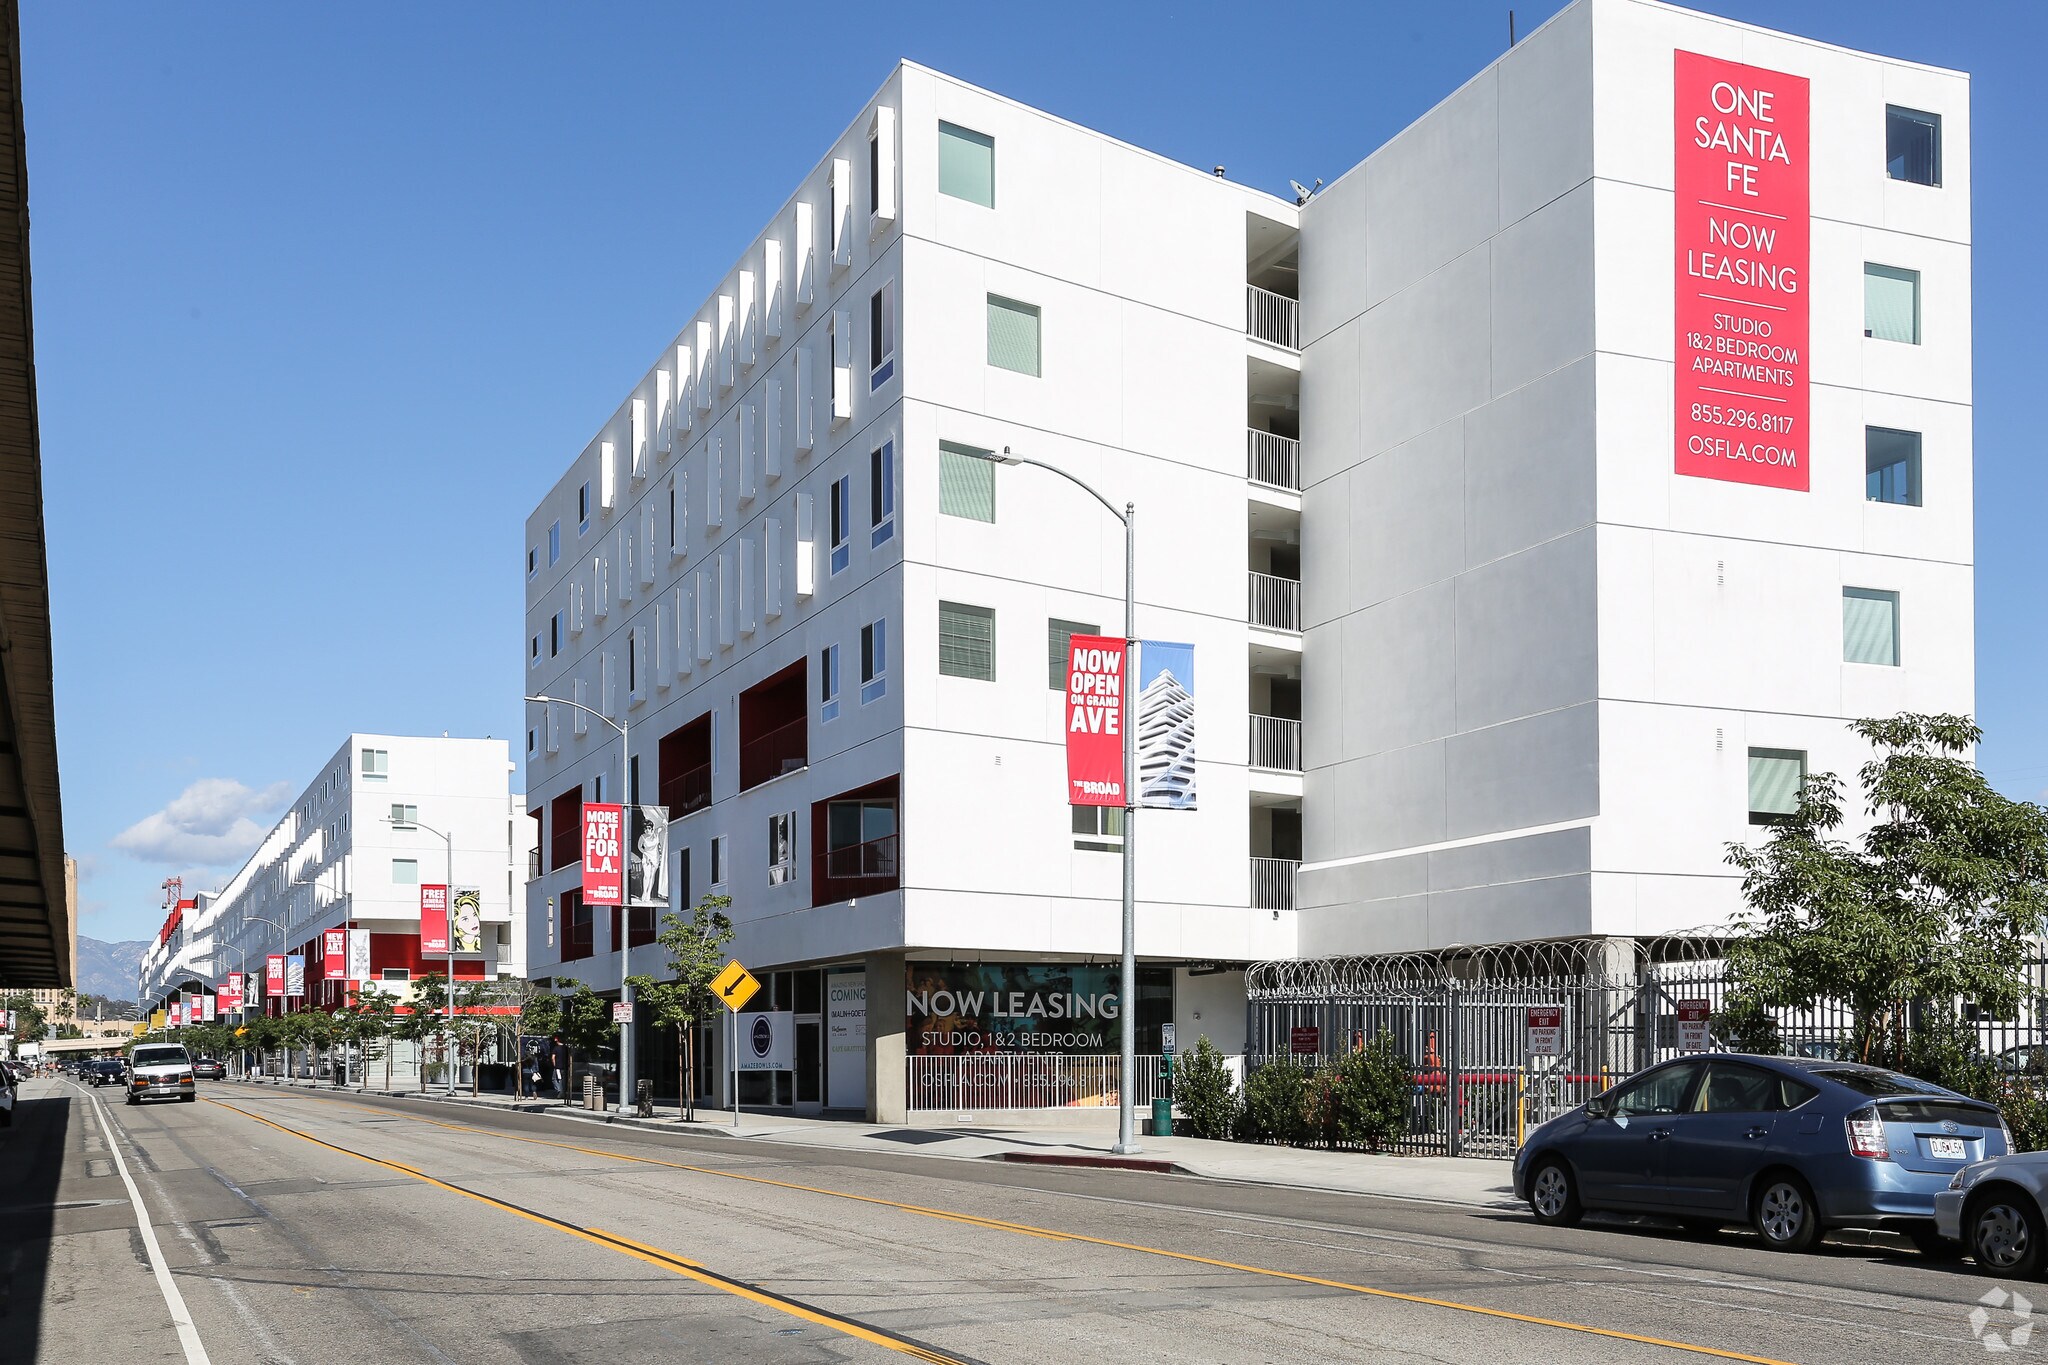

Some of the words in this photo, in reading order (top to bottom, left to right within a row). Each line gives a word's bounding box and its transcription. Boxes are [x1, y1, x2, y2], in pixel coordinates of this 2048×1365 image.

[1711, 81, 1775, 123] ONE
[1694, 116, 1791, 165] SANTA
[1727, 161, 1759, 196] FE
[1709, 217, 1776, 254] NOW
[1688, 249, 1798, 293] LEASING
[1713, 313, 1772, 338] STUDIO
[1686, 331, 1713, 351] 1&2
[1716, 336, 1799, 365] BEDROOM
[1692, 356, 1794, 387] APARTMENTS
[1691, 402, 1794, 435] 855.296.8117
[1688, 435, 1797, 468] OSFLA.COM
[1072, 648, 1121, 674] NOW
[1070, 672, 1120, 696] OPEN
[1070, 693, 1084, 706] ON
[1086, 694, 1119, 708] GRAND
[1070, 705, 1119, 735] AVE
[1073, 780, 1084, 788] THE
[1084, 781, 1120, 796] BROAD
[586, 811, 618, 823] MORE
[586, 823, 618, 839] ART
[586, 839, 618, 857] FOR
[586, 856, 618, 873] L.A.
[423, 889, 445, 899] FREE
[594, 890, 618, 898] BROAD
[326, 932, 343, 941] NEW
[326, 942, 343, 951] ART
[831, 988, 866, 1002] COMING
[906, 990, 985, 1017] NOW
[994, 992, 1119, 1019] LEASING
[1531, 1009, 1558, 1017] EMERGENCY
[1681, 1002, 1708, 1010] EMERGENCY
[1539, 1018, 1549, 1026] EXIT
[1689, 1011, 1699, 1019] EXIT
[922, 1031, 984, 1049] STUDIO,
[988, 1032, 1016, 1047] 1&2
[1022, 1033, 1103, 1047] BEDROOM
[962, 1051, 1064, 1065] APARTMENTS
